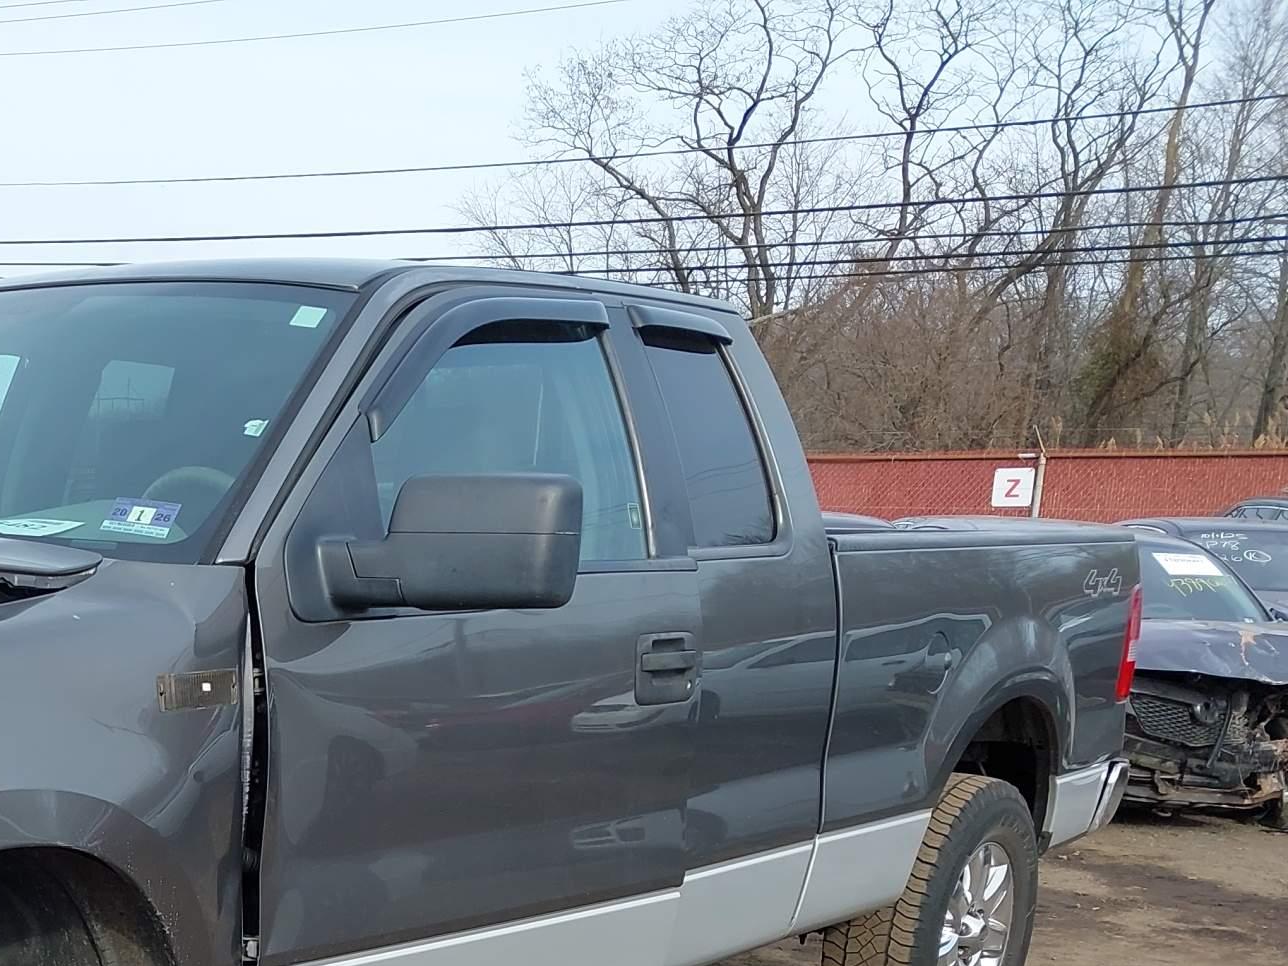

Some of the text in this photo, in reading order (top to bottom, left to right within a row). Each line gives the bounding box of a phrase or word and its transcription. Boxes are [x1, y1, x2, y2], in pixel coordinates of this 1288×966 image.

[1004, 478, 1022, 498] Z
[112, 507, 172, 523] 20 1 26
